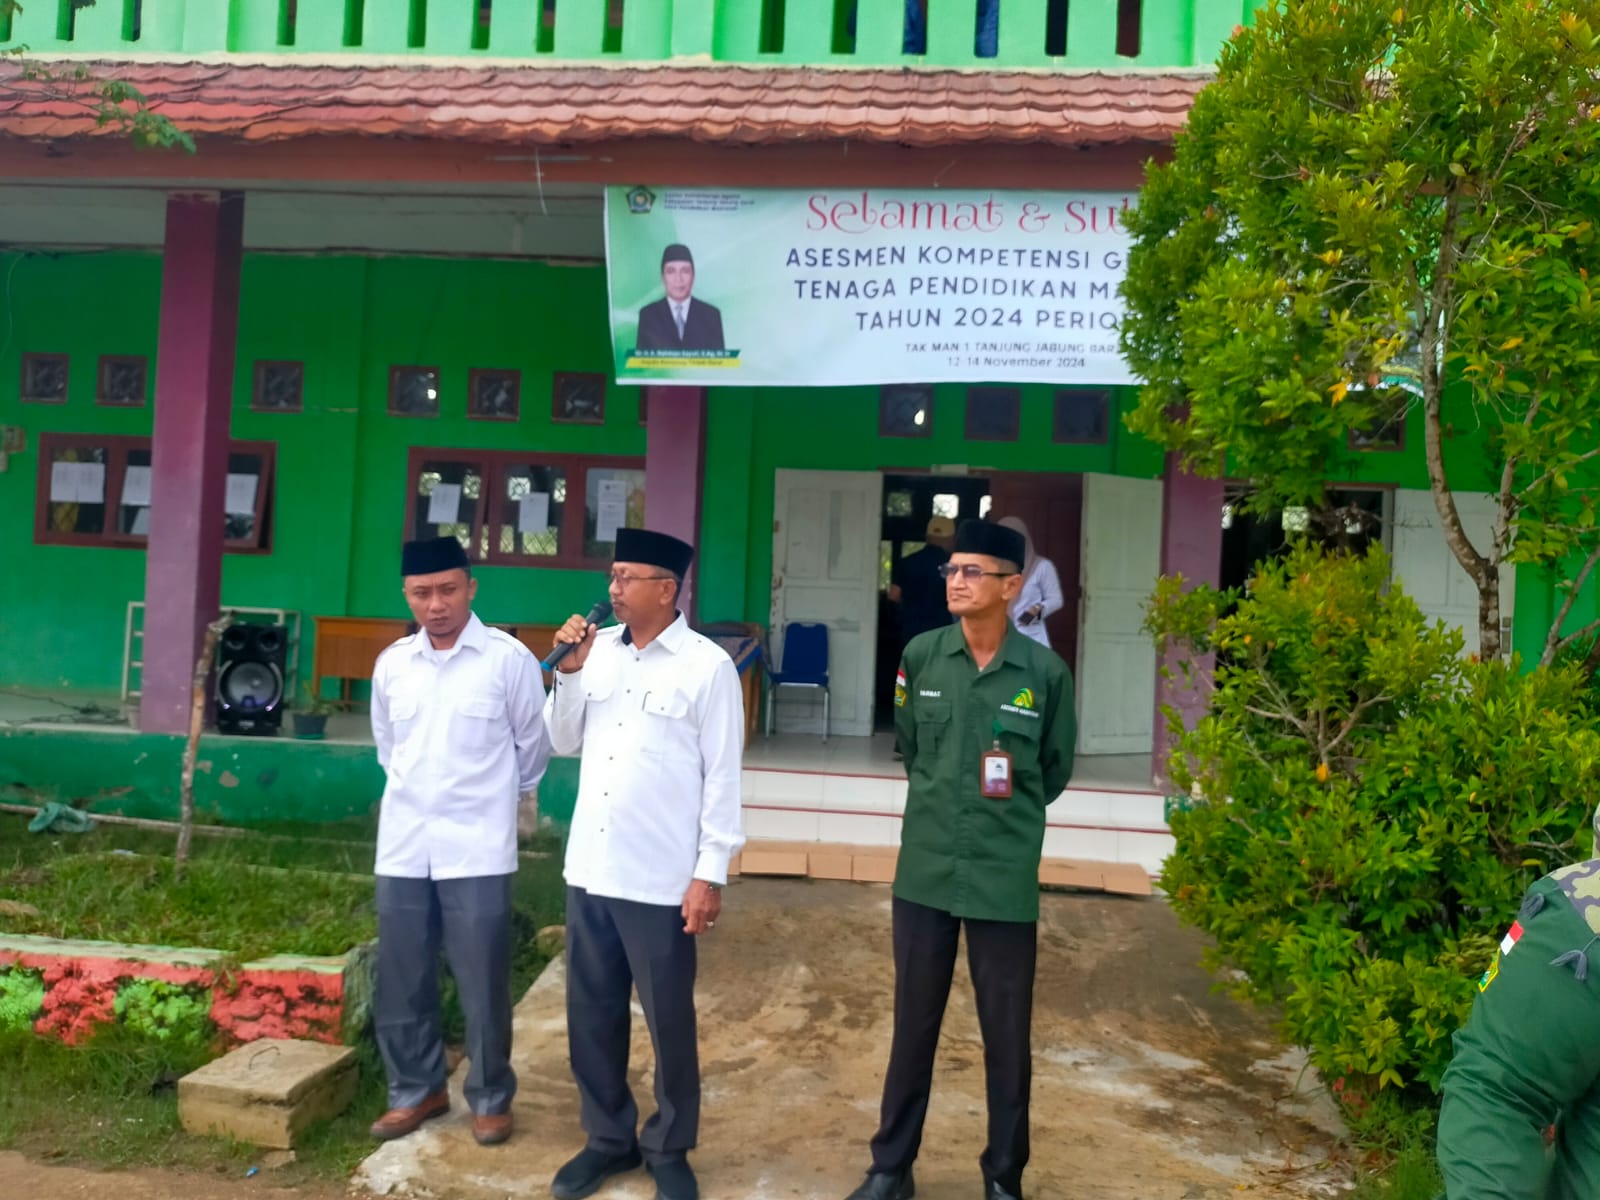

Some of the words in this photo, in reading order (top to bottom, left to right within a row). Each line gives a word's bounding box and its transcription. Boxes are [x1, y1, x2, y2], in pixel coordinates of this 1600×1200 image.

[806, 191, 1004, 234] Selamat
[1018, 201, 1051, 233] &
[786, 245, 906, 268] ASESMEN
[919, 245, 1089, 269] KOMPETENSI
[794, 278, 896, 299] TENAGA
[910, 276, 1076, 299] PENDIDIKAN
[856, 308, 941, 331] TAHUN
[954, 307, 1022, 327] 2024
[1036, 310, 1120, 330] PERIO
[931, 342, 959, 352] MAN
[975, 342, 1032, 353] TANJUNG
[1036, 343, 1085, 354] JABUNG
[1089, 344, 1116, 354] BAR
[984, 356, 1052, 367] November
[1057, 357, 1086, 368] 2024
